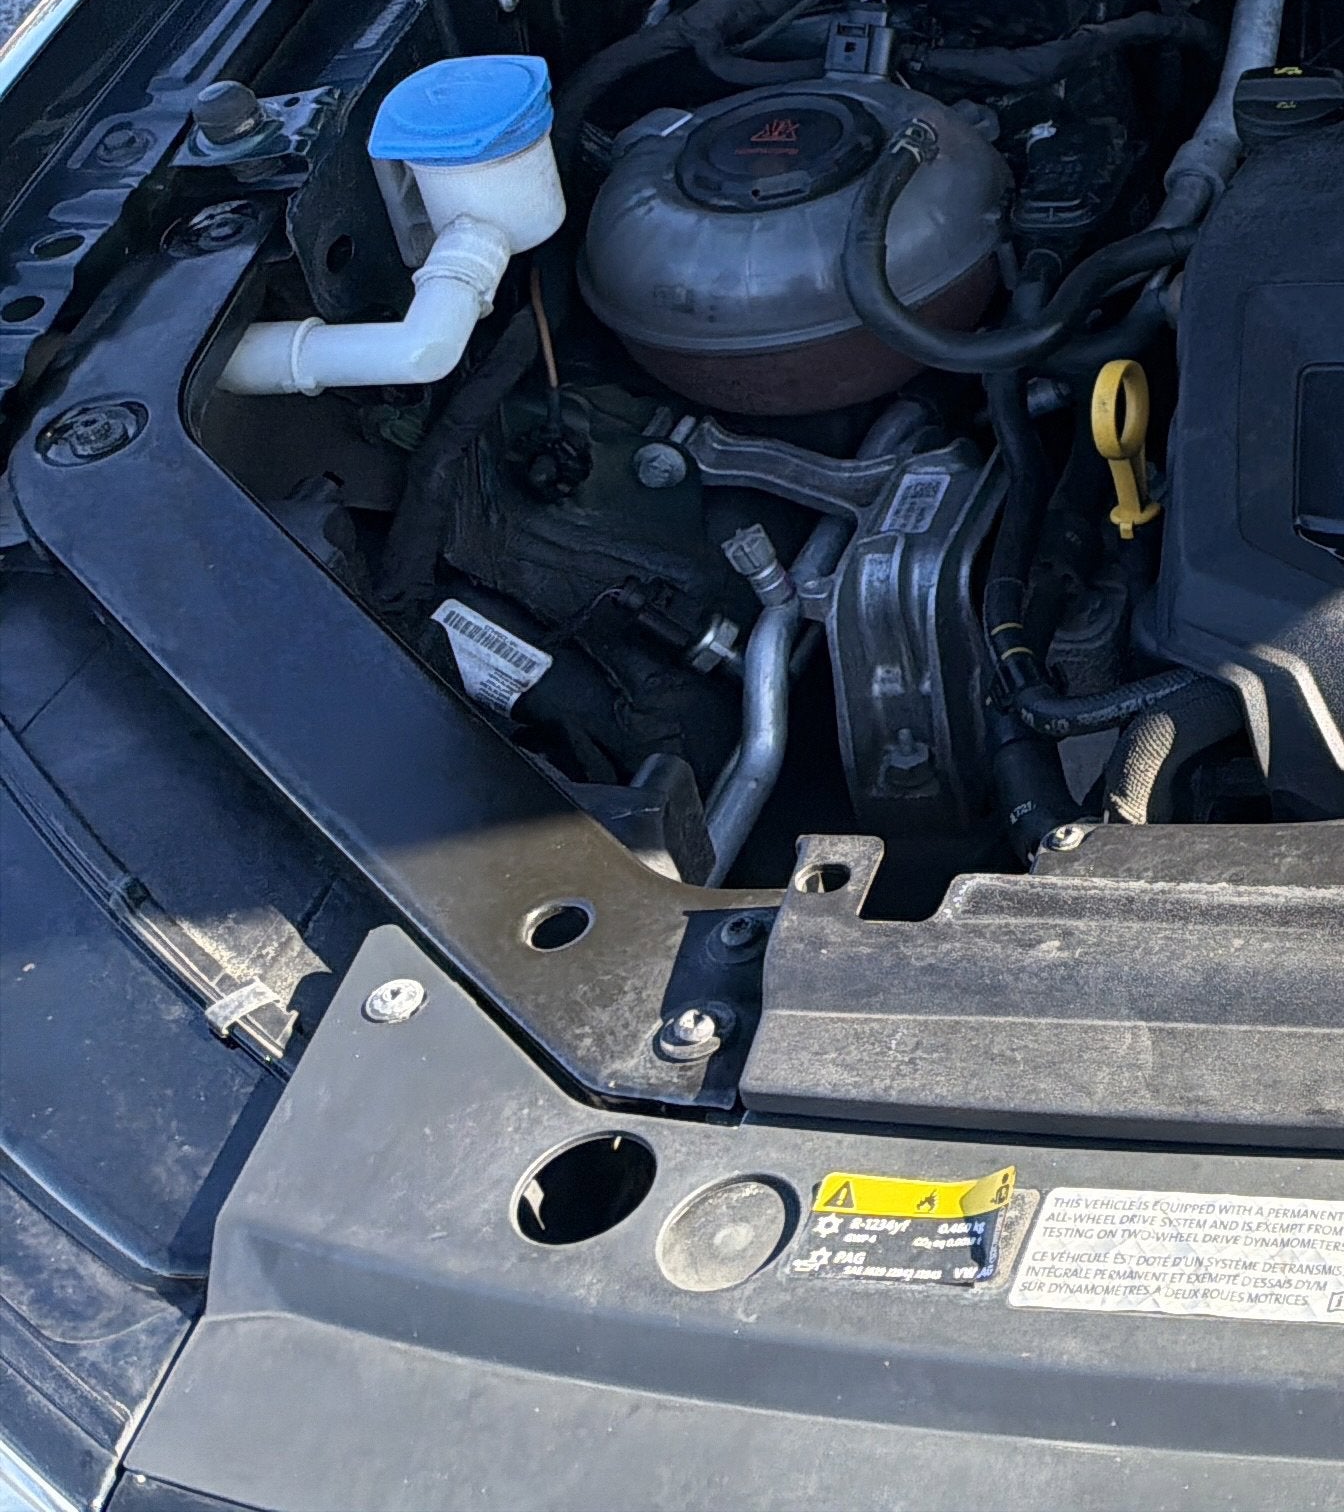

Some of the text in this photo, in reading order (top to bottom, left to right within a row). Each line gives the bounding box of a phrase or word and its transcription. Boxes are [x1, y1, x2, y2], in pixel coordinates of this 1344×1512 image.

[1051, 1196, 1344, 1222] THIS VEHICLE IS EQUIPPED WITH A PERMANENT
[1044, 1210, 1118, 1225] ALL-WHEEL
[1118, 1213, 1158, 1226] DRIVE
[1158, 1215, 1208, 1229] SYSTEM
[1208, 1218, 1240, 1231] AND
[1239, 1220, 1254, 1232] IS
[1254, 1221, 1306, 1235] EXEMPT
[1305, 1223, 1344, 1236] FROM
[1039, 1225, 1095, 1240] TESTING
[1095, 1227, 1118, 1240] ON
[1117, 1228, 1201, 1244] TWO-WHEEL
[1200, 1233, 1241, 1246] DRIVE
[833, 1251, 867, 1265] PAG
[1029, 1250, 1050, 1262] CE
[1111, 1252, 1135, 1265] EST
[1170, 1255, 1205, 1268] D'UN
[1260, 1262, 1282, 1273] DE
[953, 1266, 978, 1280] VW
[1092, 1267, 1169, 1283] PERMANENT
[1168, 1272, 1184, 1284] ET
[1239, 1275, 1294, 1290] D'ESSAIS
[1018, 1280, 1246, 1303] SUR DEUX ROUES
